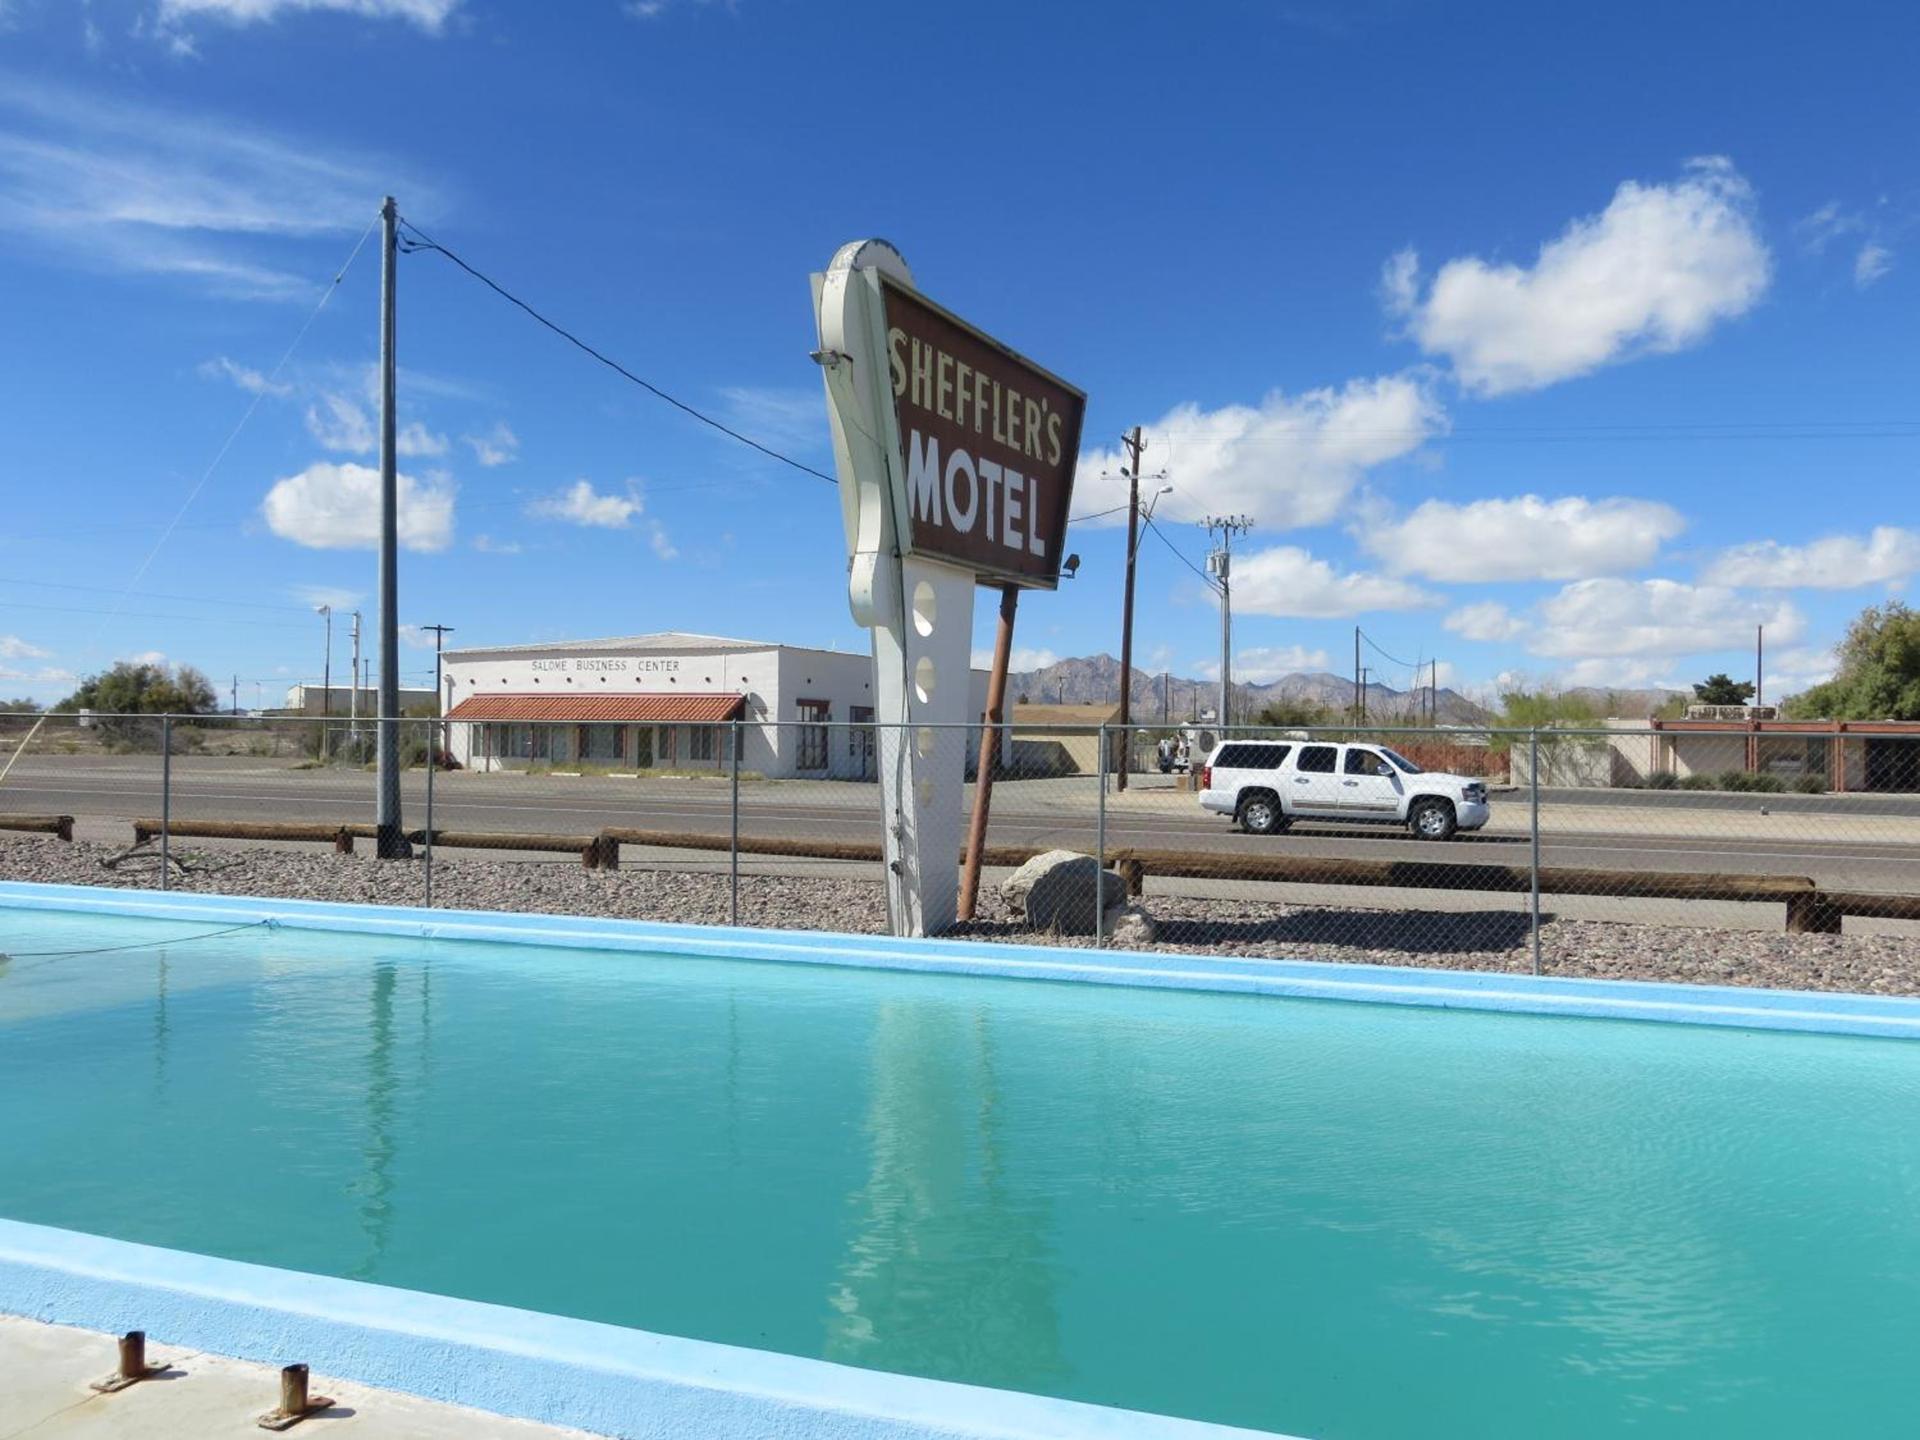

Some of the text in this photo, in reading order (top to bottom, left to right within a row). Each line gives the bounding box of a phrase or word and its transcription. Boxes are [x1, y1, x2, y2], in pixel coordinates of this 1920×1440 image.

[888, 327, 1062, 467] SHEFFLER'S
[907, 428, 1046, 557] MOTEL
[531, 660, 680, 672] SALOME BUSINESS CENTER
